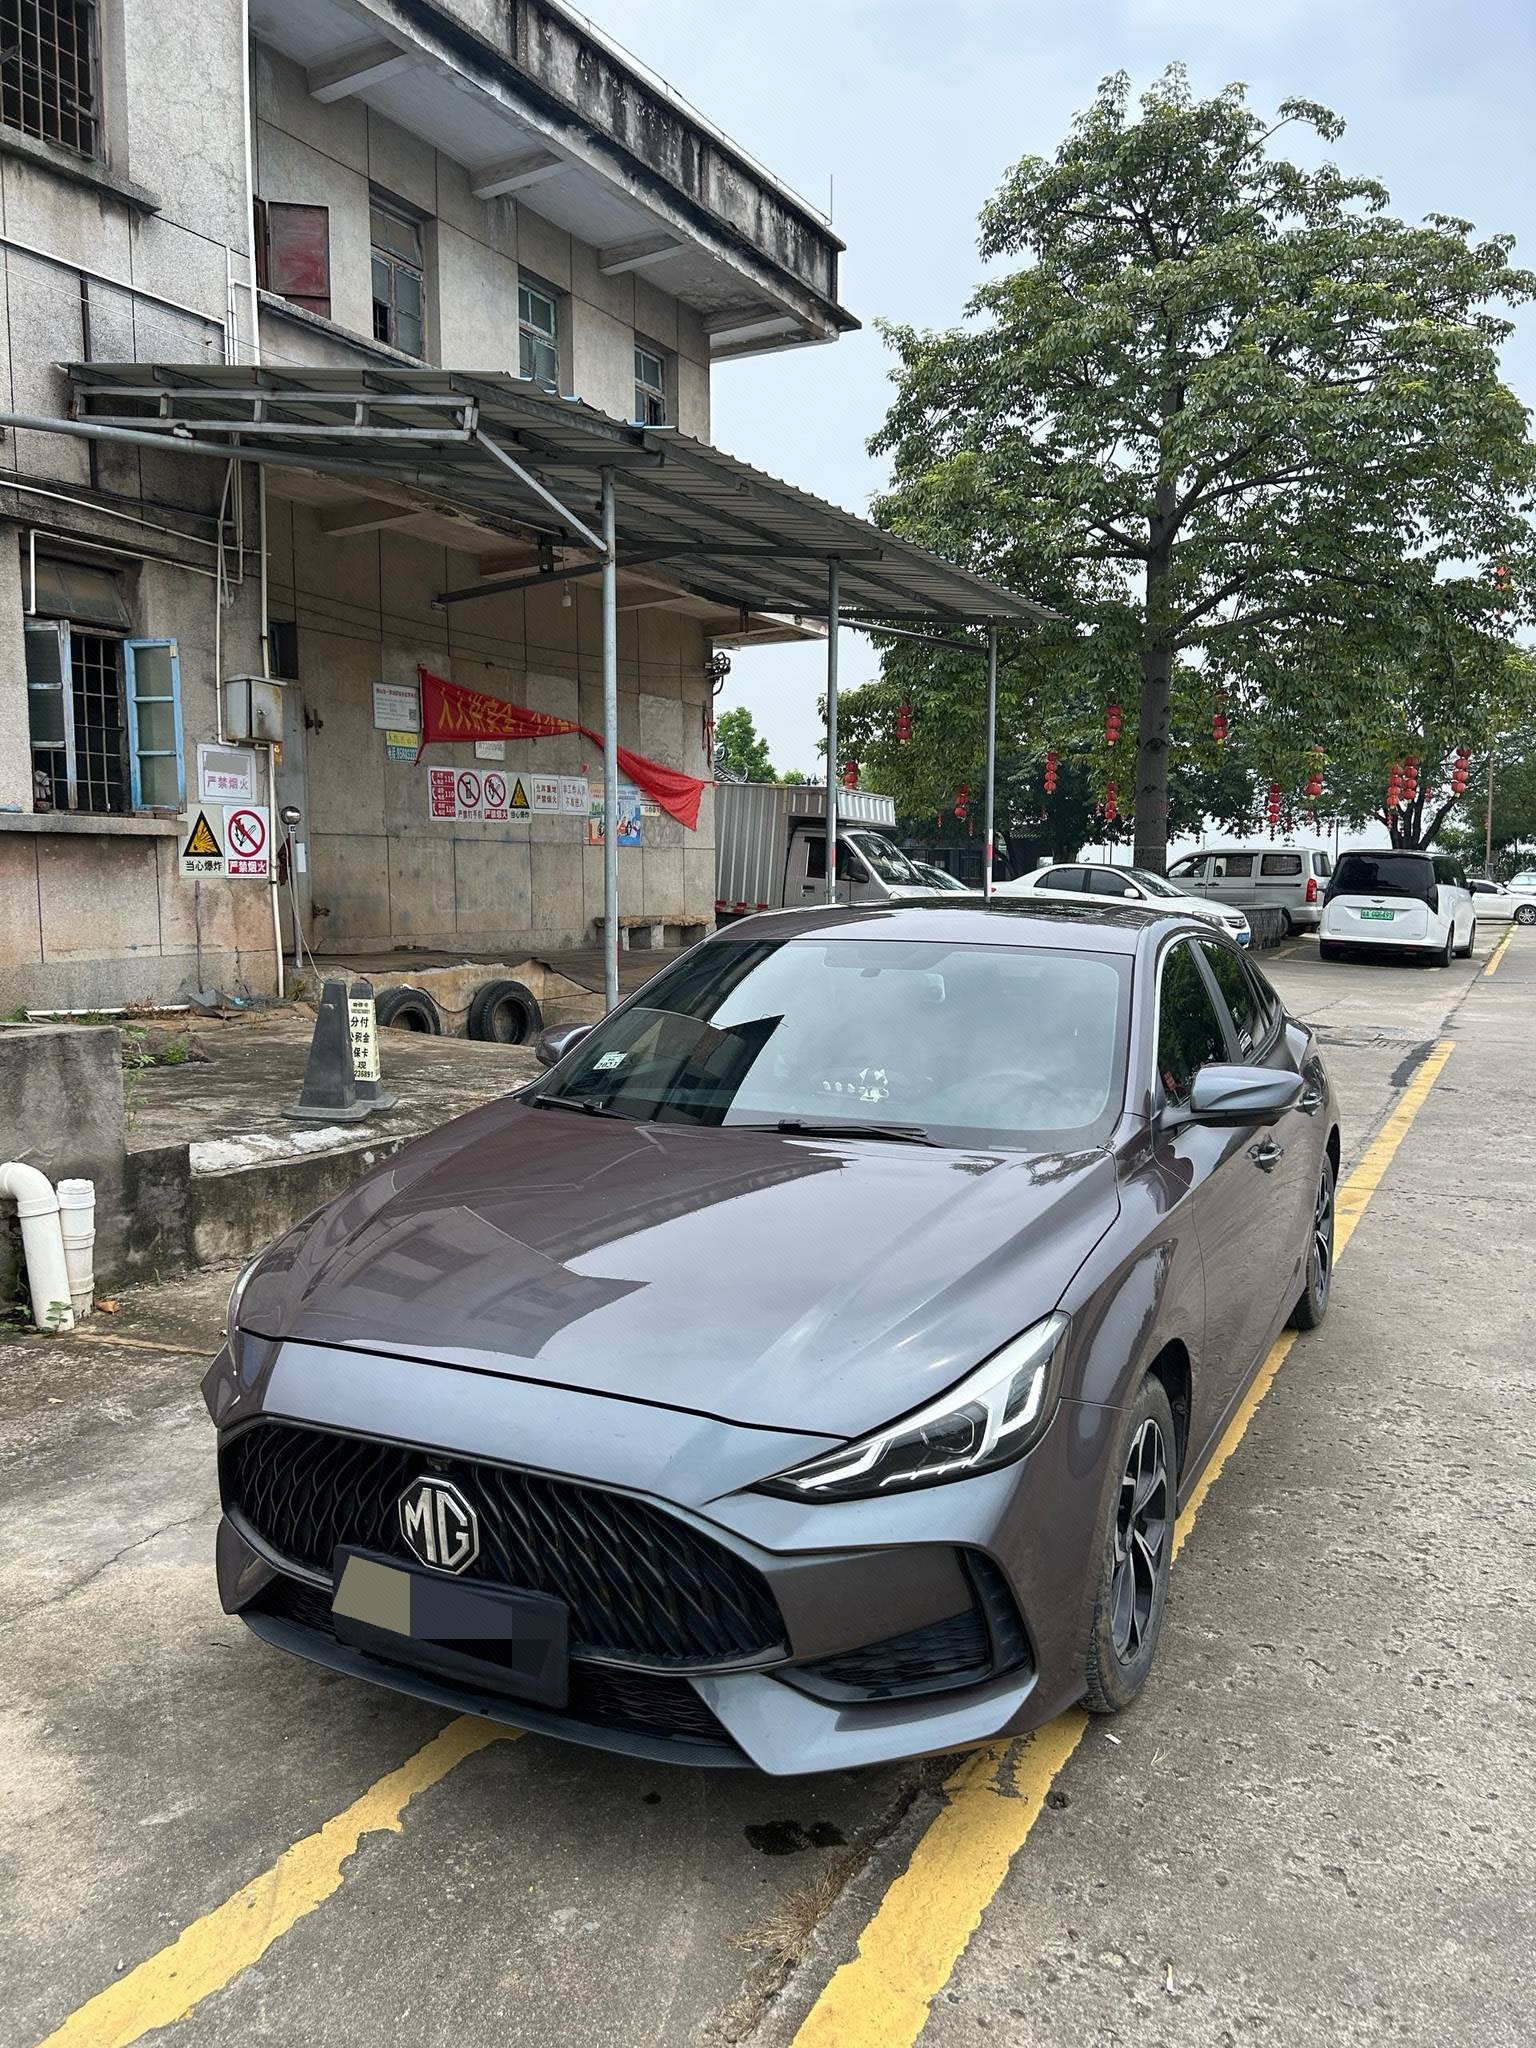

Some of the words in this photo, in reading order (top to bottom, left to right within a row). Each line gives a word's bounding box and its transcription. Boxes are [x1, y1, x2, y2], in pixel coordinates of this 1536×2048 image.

[207, 775, 249, 790] 严禁烟火
[184, 860, 222, 872] 当心爆炸
[229, 861, 267, 873] 严禁烟火
[404, 1487, 471, 1567] MG
